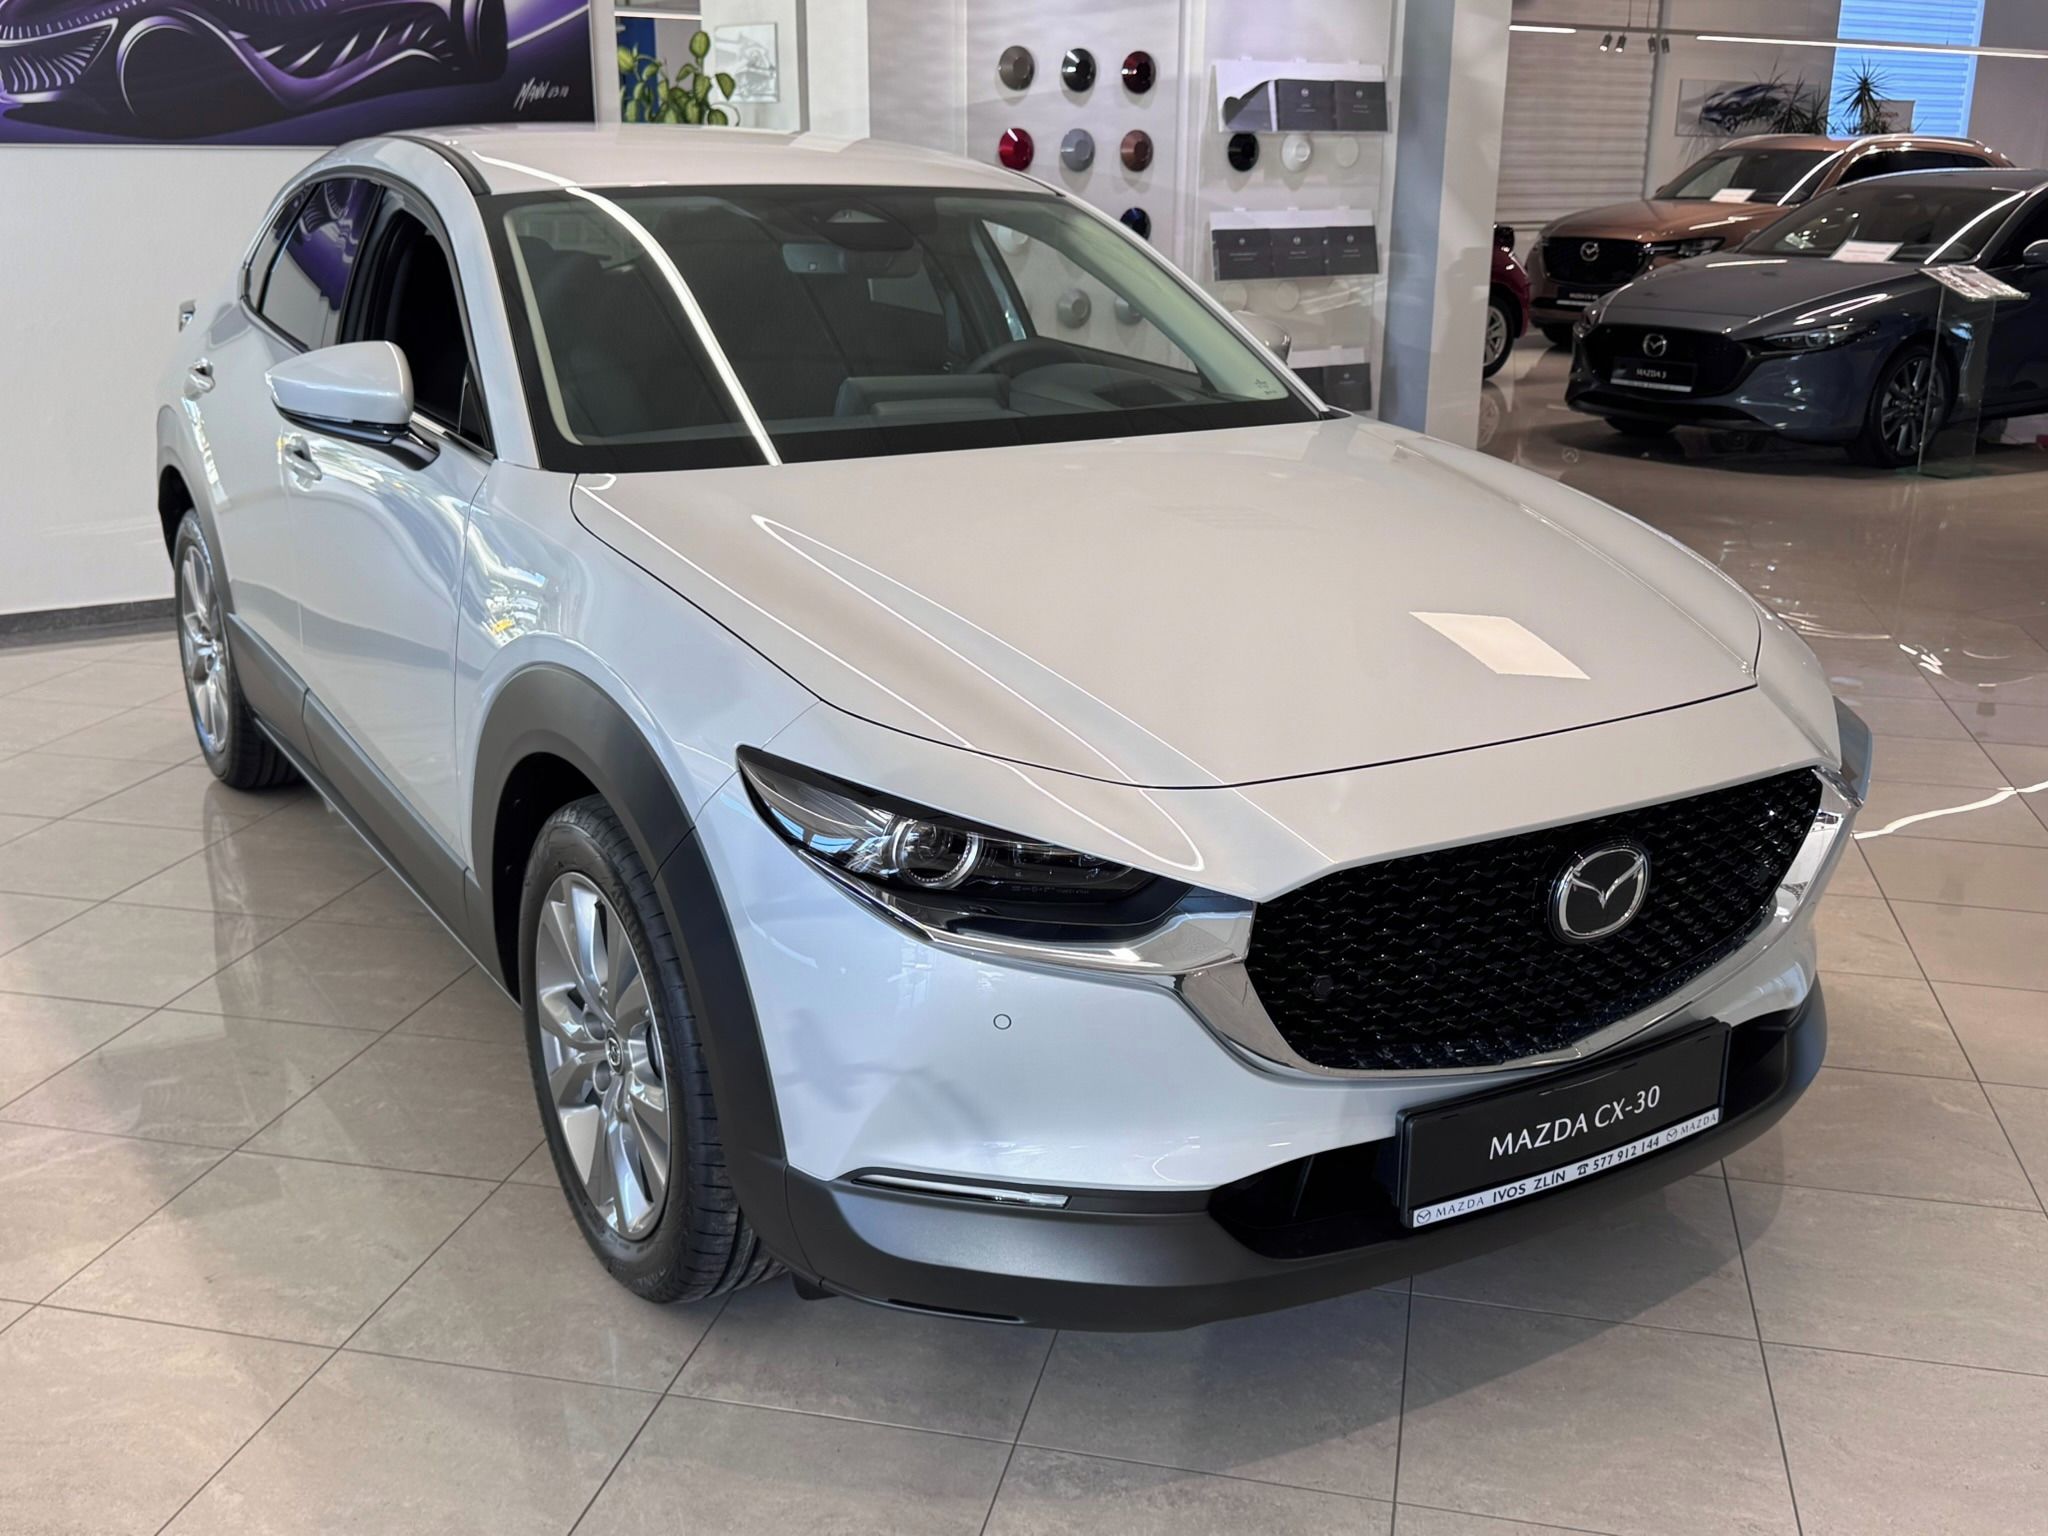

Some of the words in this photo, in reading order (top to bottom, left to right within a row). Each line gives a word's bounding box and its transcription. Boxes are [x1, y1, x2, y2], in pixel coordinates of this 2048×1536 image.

[1435, 1196, 1485, 1218] MAZDA
[1492, 1183, 1527, 1203] IVOS
[1533, 1169, 1566, 1190] ZLÍN
[1592, 1154, 1614, 1171] 577
[1617, 1147, 1637, 1162] 912
[1641, 1136, 1660, 1153] 144
[1680, 1114, 1717, 1136] MAZDA
[1489, 1113, 1588, 1160] MAZDA
[1594, 1085, 1661, 1128] CX-30
